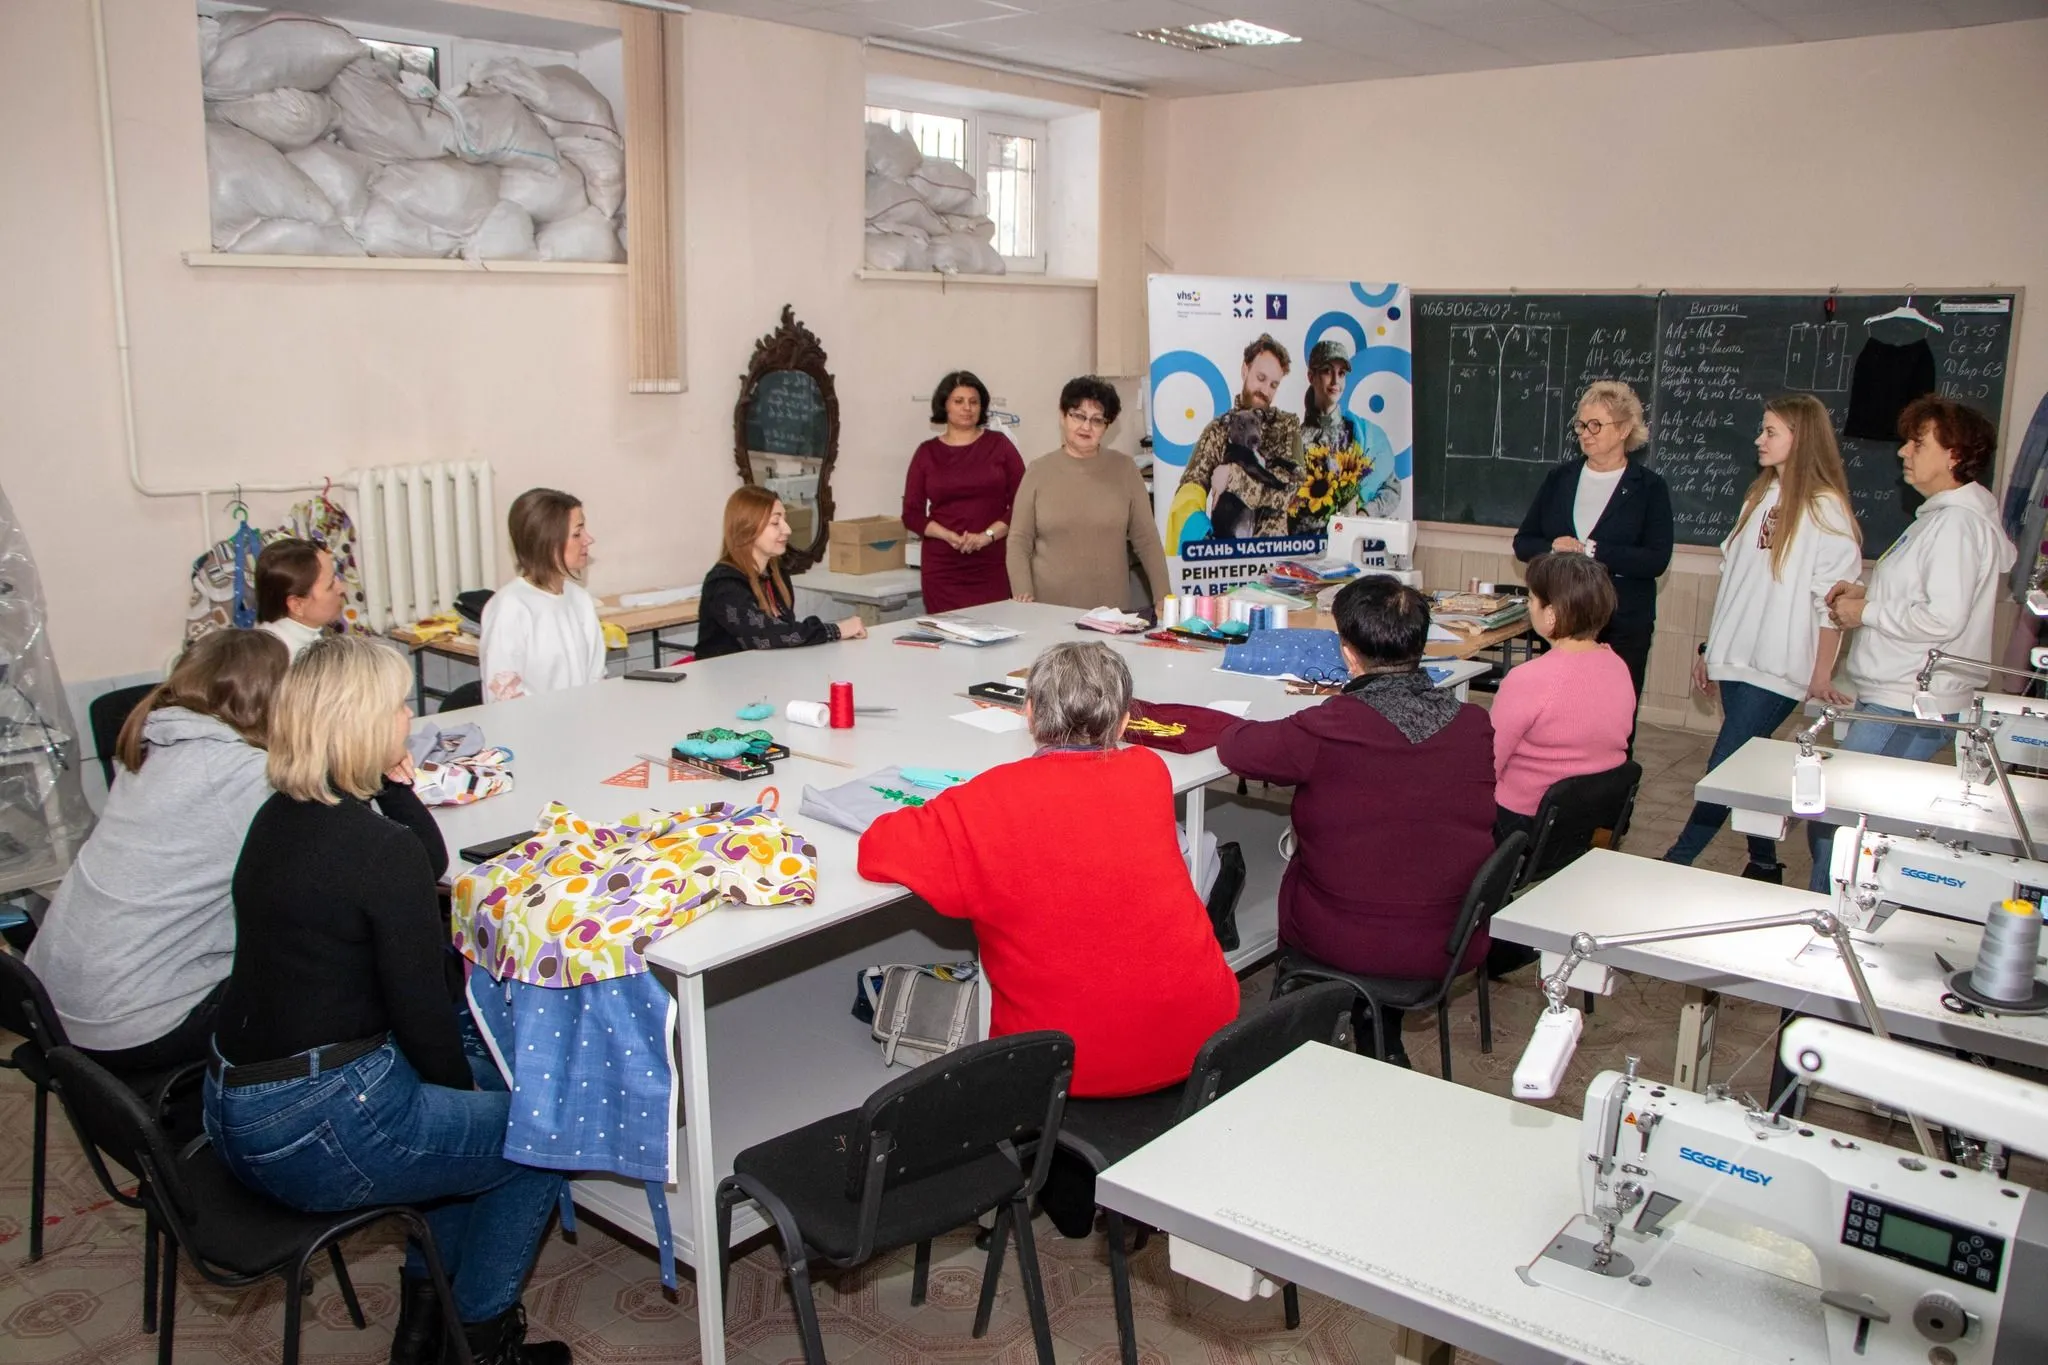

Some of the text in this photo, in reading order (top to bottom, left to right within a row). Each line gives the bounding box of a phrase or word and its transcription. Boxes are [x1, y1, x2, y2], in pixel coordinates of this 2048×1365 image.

[1177, 290, 1192, 300] vhs
[1186, 543, 1234, 557] СТАНЬ
[1236, 539, 1316, 555] ЧАСТИНОЮ
[1182, 563, 1273, 581] РЕІНТЕГРА
